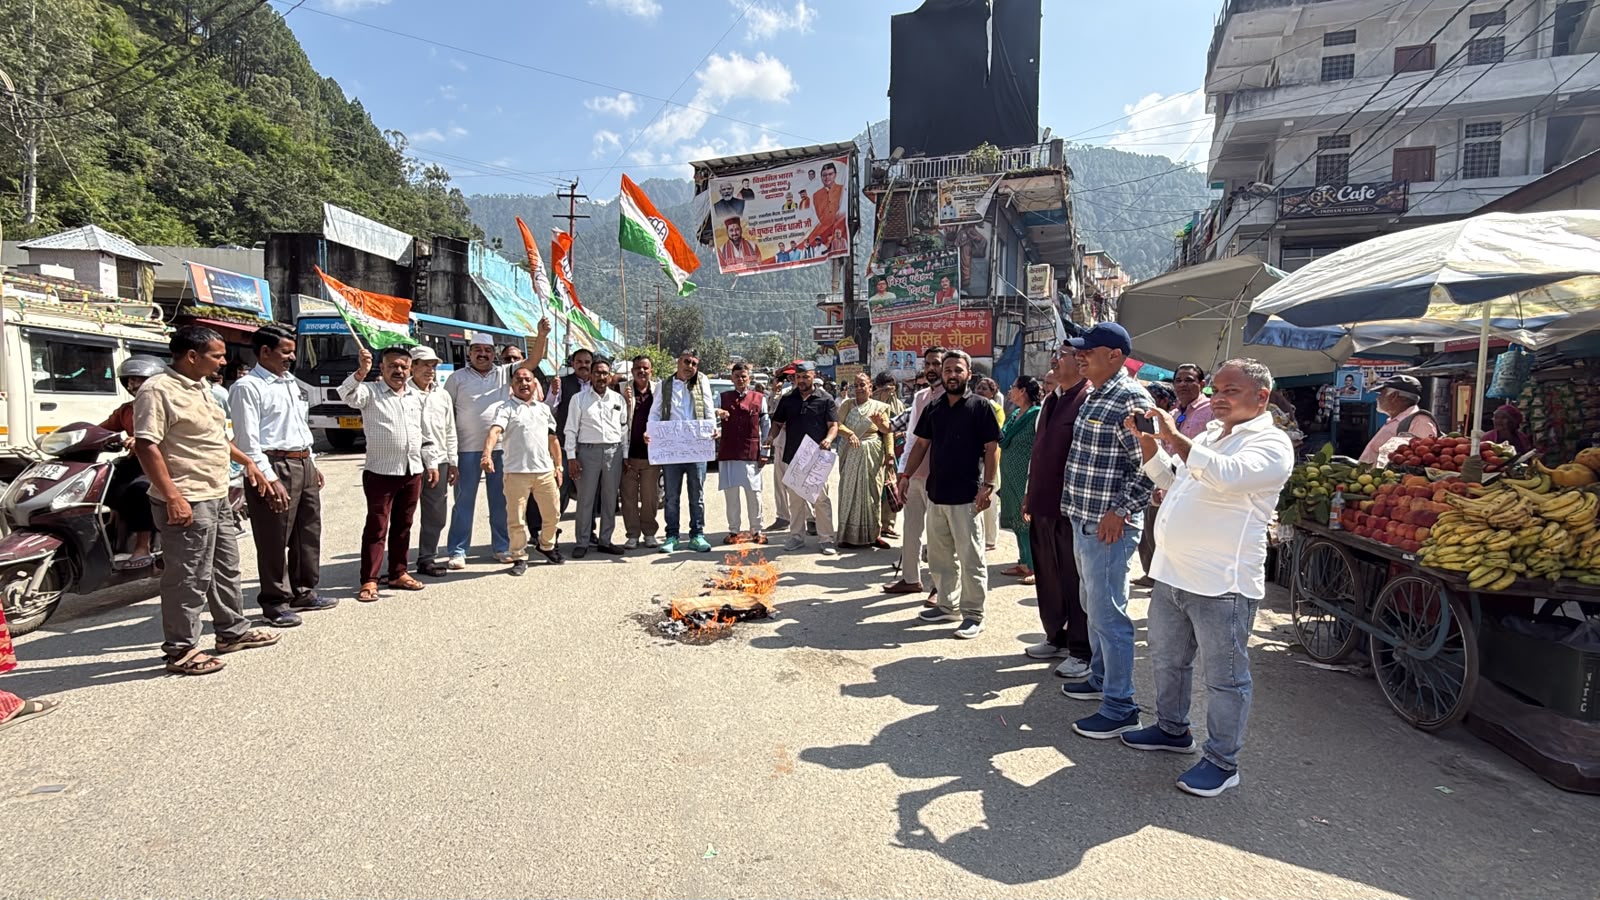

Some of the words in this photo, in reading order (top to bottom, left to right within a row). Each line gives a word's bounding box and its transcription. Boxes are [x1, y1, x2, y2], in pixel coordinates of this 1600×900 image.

[1337, 186, 1376, 201] Cafe
[756, 226, 773, 237] पुष्कर
[774, 222, 787, 232] सिंह
[788, 220, 802, 230] धामी
[804, 218, 812, 228] जी
[932, 319, 953, 330] हार्दिक
[956, 320, 976, 328] स्वागत
[893, 330, 918, 350] सुरेश
[920, 330, 942, 346] सिंह
[948, 328, 987, 348] चौहान
